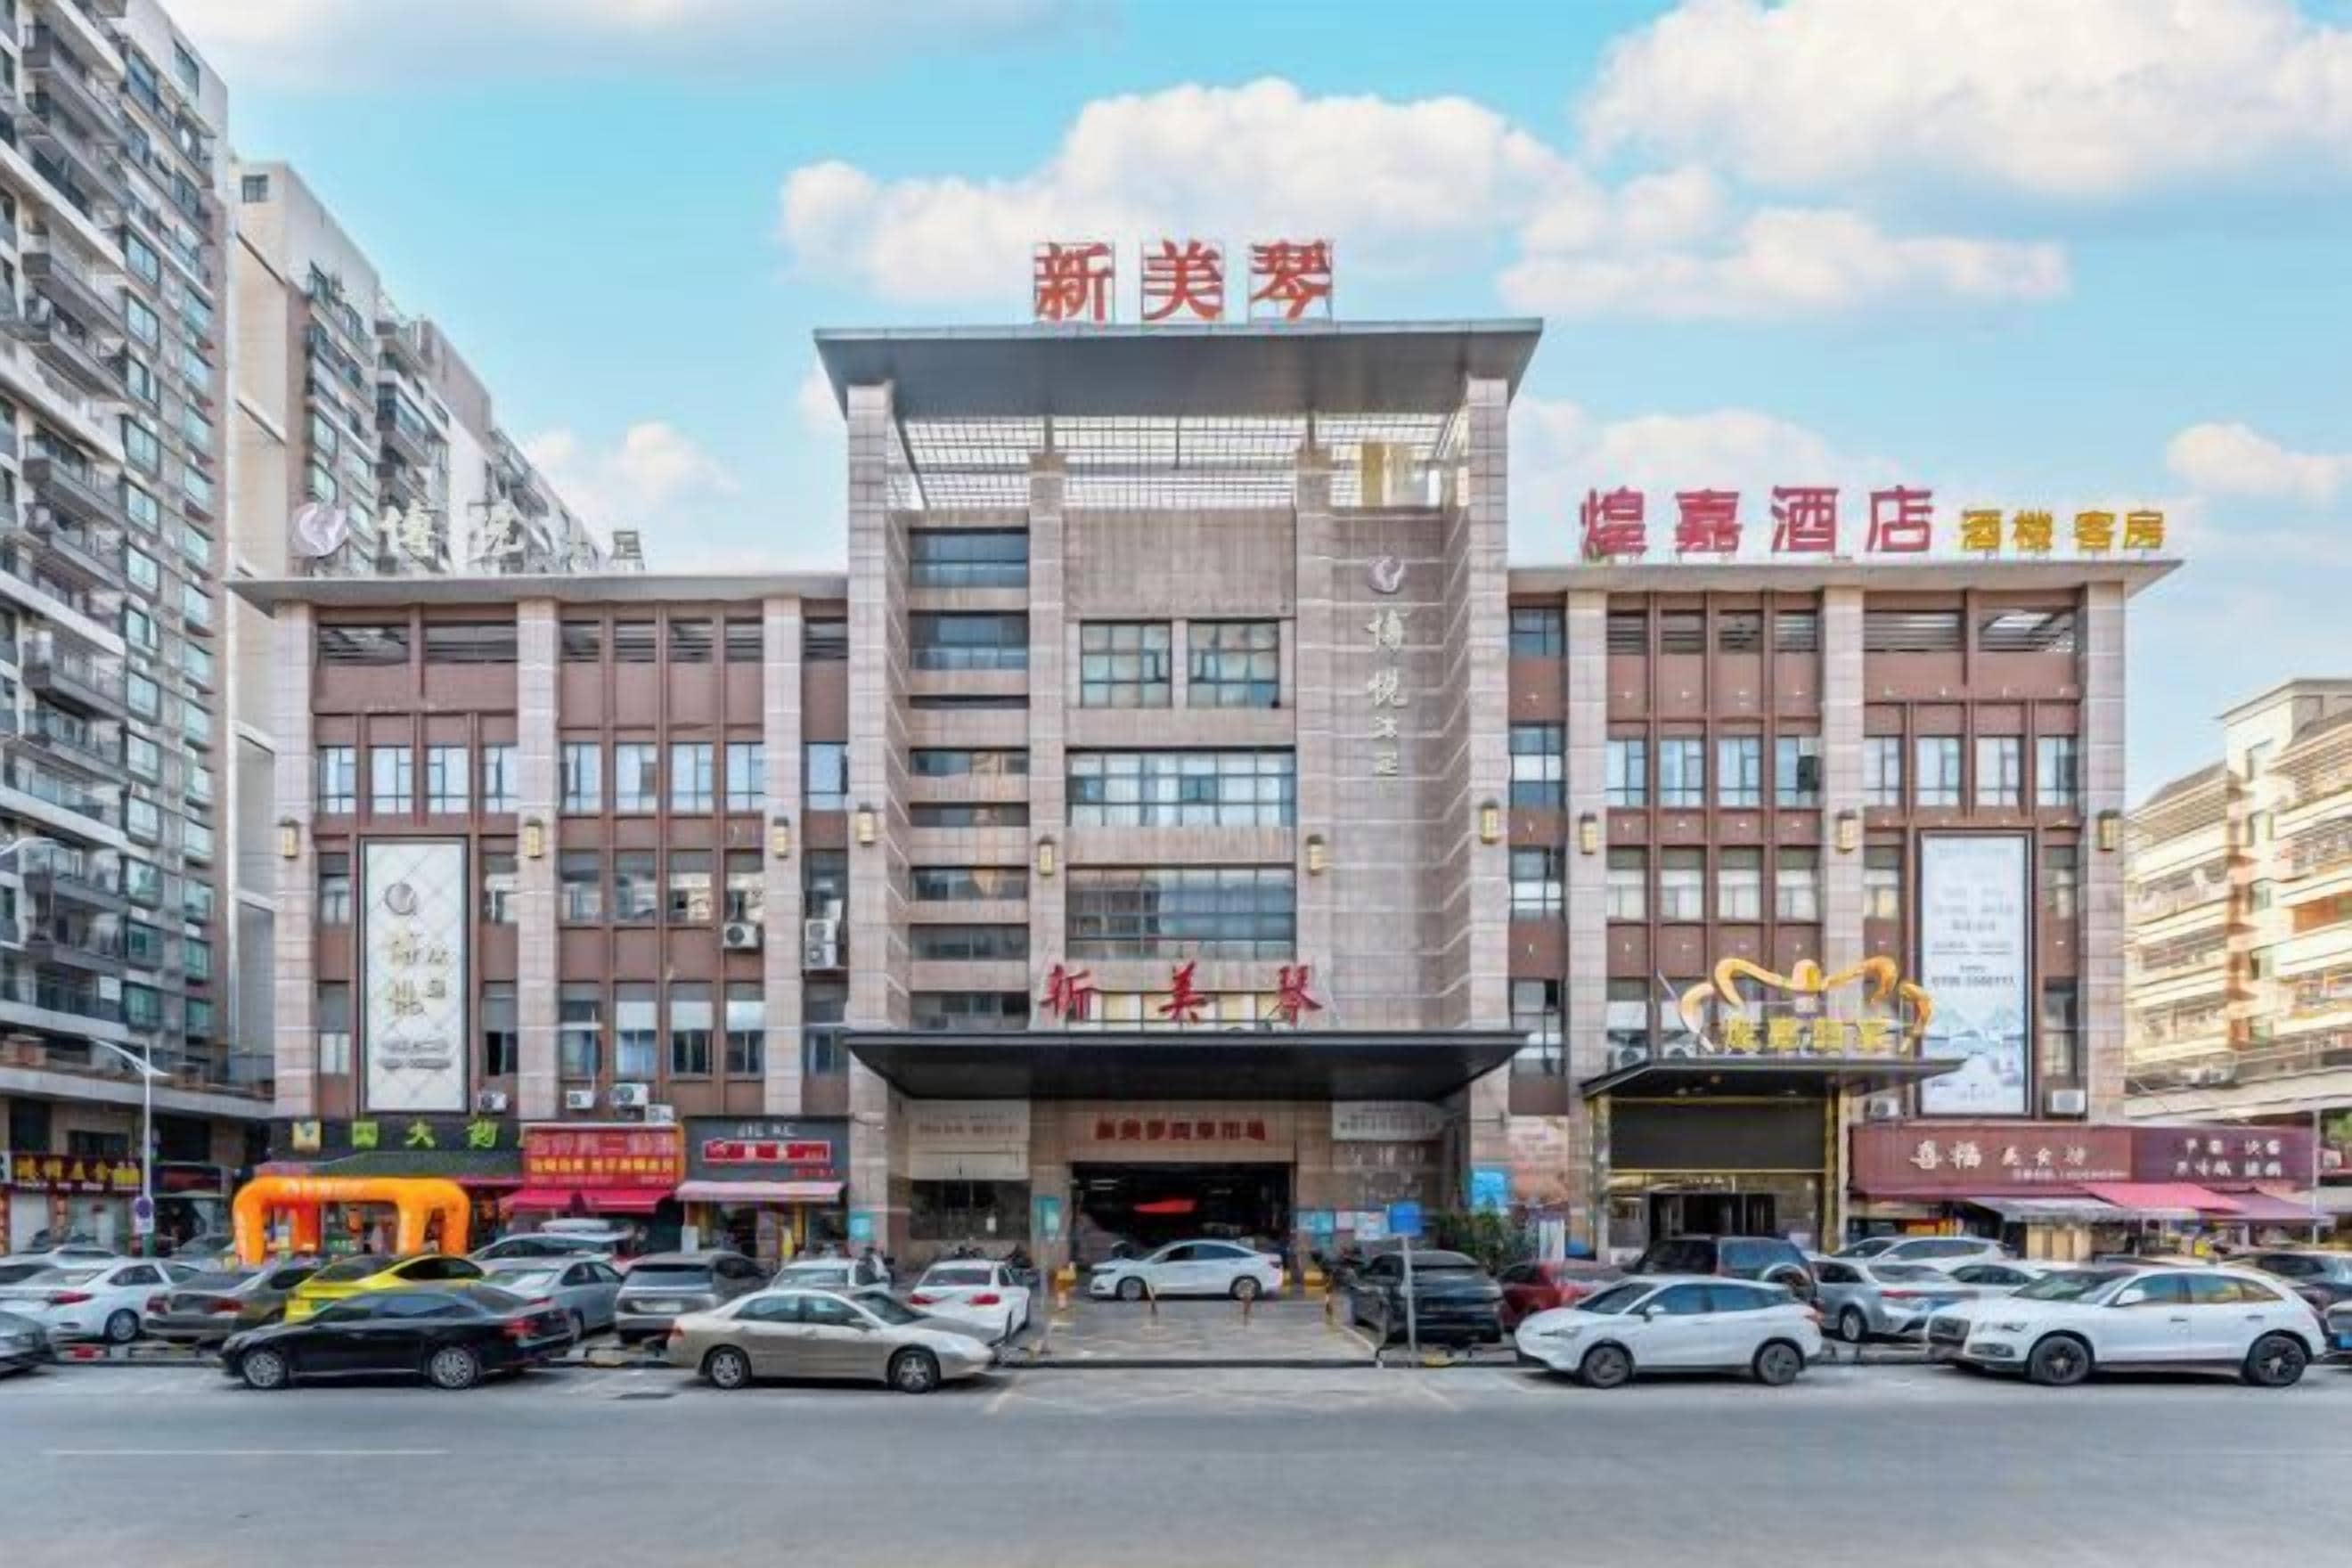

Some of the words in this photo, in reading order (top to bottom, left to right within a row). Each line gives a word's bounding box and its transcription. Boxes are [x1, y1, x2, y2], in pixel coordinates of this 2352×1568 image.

[1033, 239, 1333, 323] 新美琴
[1580, 485, 1933, 557] 煌嘉酒店
